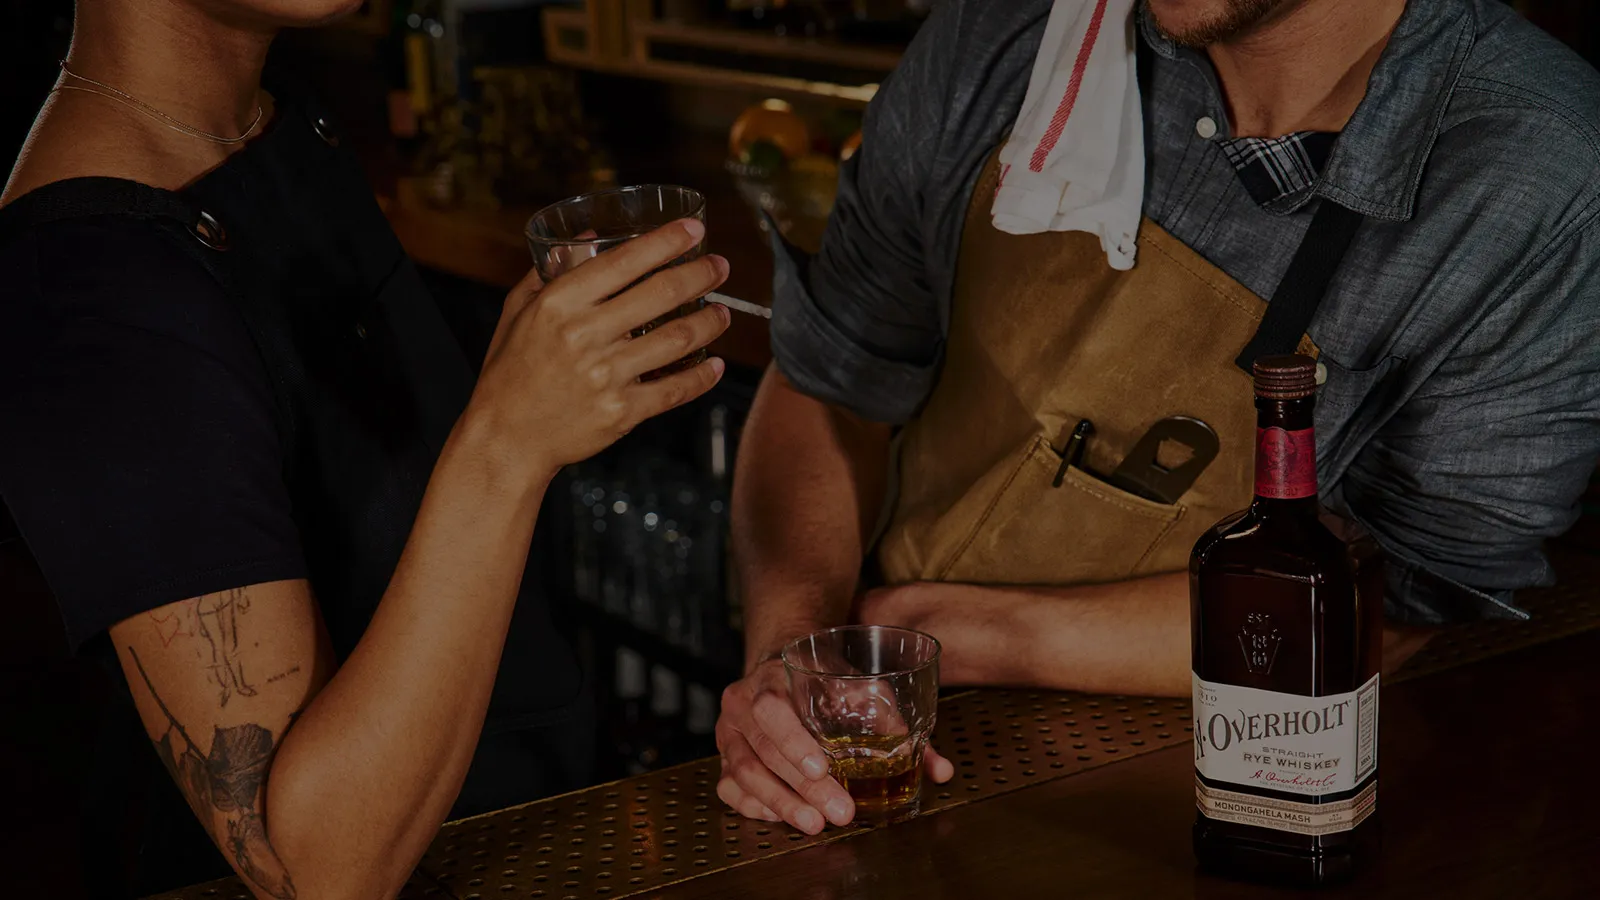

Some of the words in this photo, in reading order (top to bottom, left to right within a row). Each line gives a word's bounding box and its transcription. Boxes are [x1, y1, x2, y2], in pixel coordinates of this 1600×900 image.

[1208, 701, 1349, 752] OVERHOLT
[1243, 753, 1271, 765] RYE
[1276, 758, 1340, 770] WHISKEY
[1262, 746, 1324, 760] STRAIGHT
[1214, 800, 1283, 819] MONONGAHELA
[1284, 811, 1311, 824] MASH
